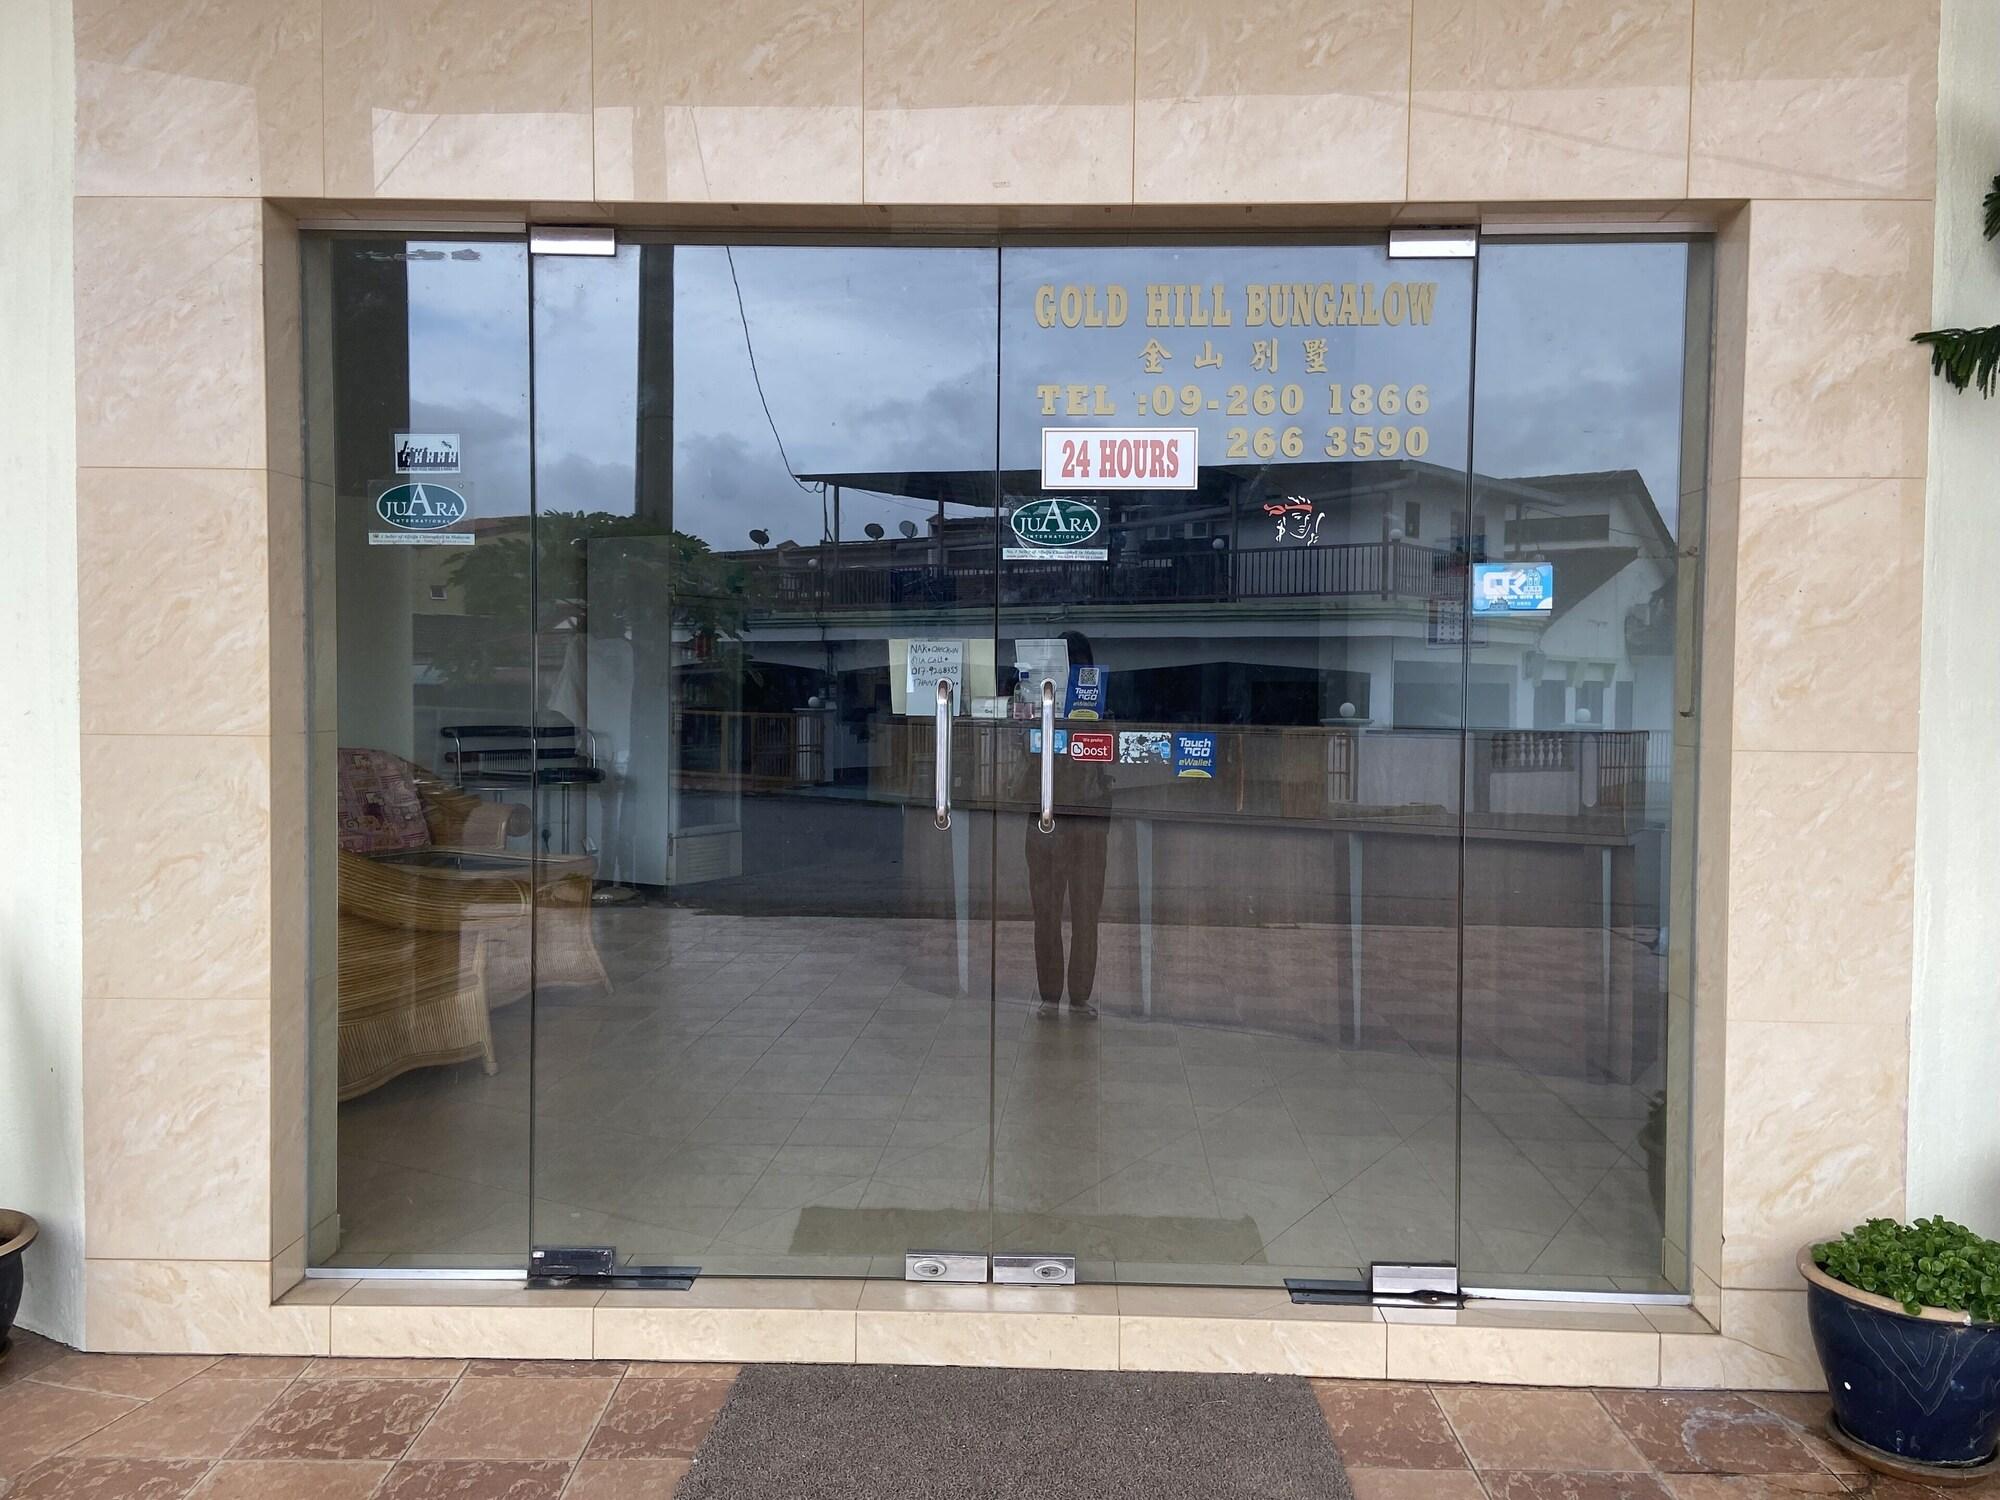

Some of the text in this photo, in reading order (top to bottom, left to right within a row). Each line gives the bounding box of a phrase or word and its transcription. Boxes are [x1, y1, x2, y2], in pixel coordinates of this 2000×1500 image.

[1035, 282, 1439, 328] GOLD HILL BUNGALOW
[1037, 384, 1115, 416] TEL
[1328, 384, 1430, 415] 1866
[1061, 438, 1179, 478] 24 HOURS
[1226, 426, 1430, 458] 266 3590
[384, 482, 460, 518] JUARA
[1019, 498, 1094, 535] JUARA
[1179, 737, 1211, 748] Touch
[1179, 758, 1212, 767] eWallet
